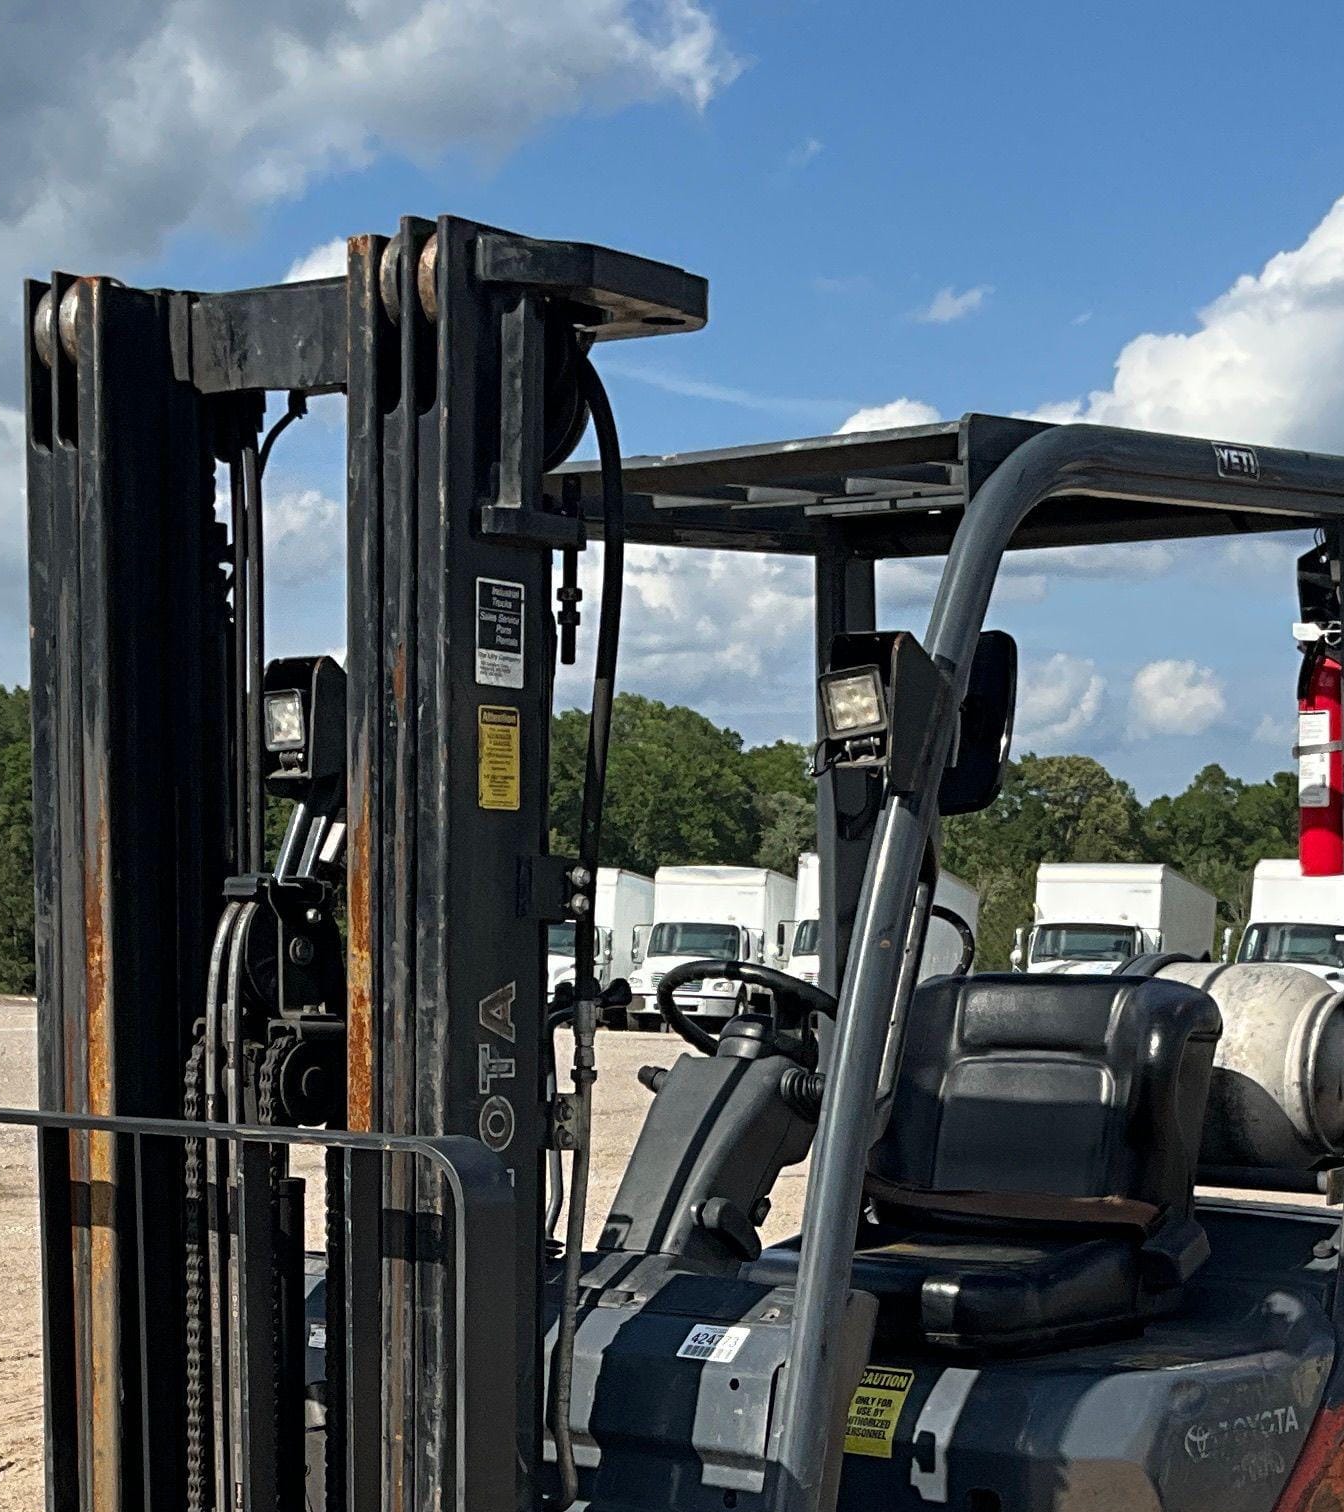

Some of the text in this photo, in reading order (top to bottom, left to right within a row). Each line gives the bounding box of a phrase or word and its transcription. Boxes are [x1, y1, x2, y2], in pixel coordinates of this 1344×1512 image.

[1217, 447, 1256, 474] YETI
[479, 980, 516, 1187] OTA
[691, 1331, 740, 1348] 424773
[876, 1397, 893, 1408] FOR
[856, 1406, 885, 1418] USE BY
[848, 1415, 891, 1430] UTHORIZED
[846, 1426, 887, 1441] ERSONNEL
